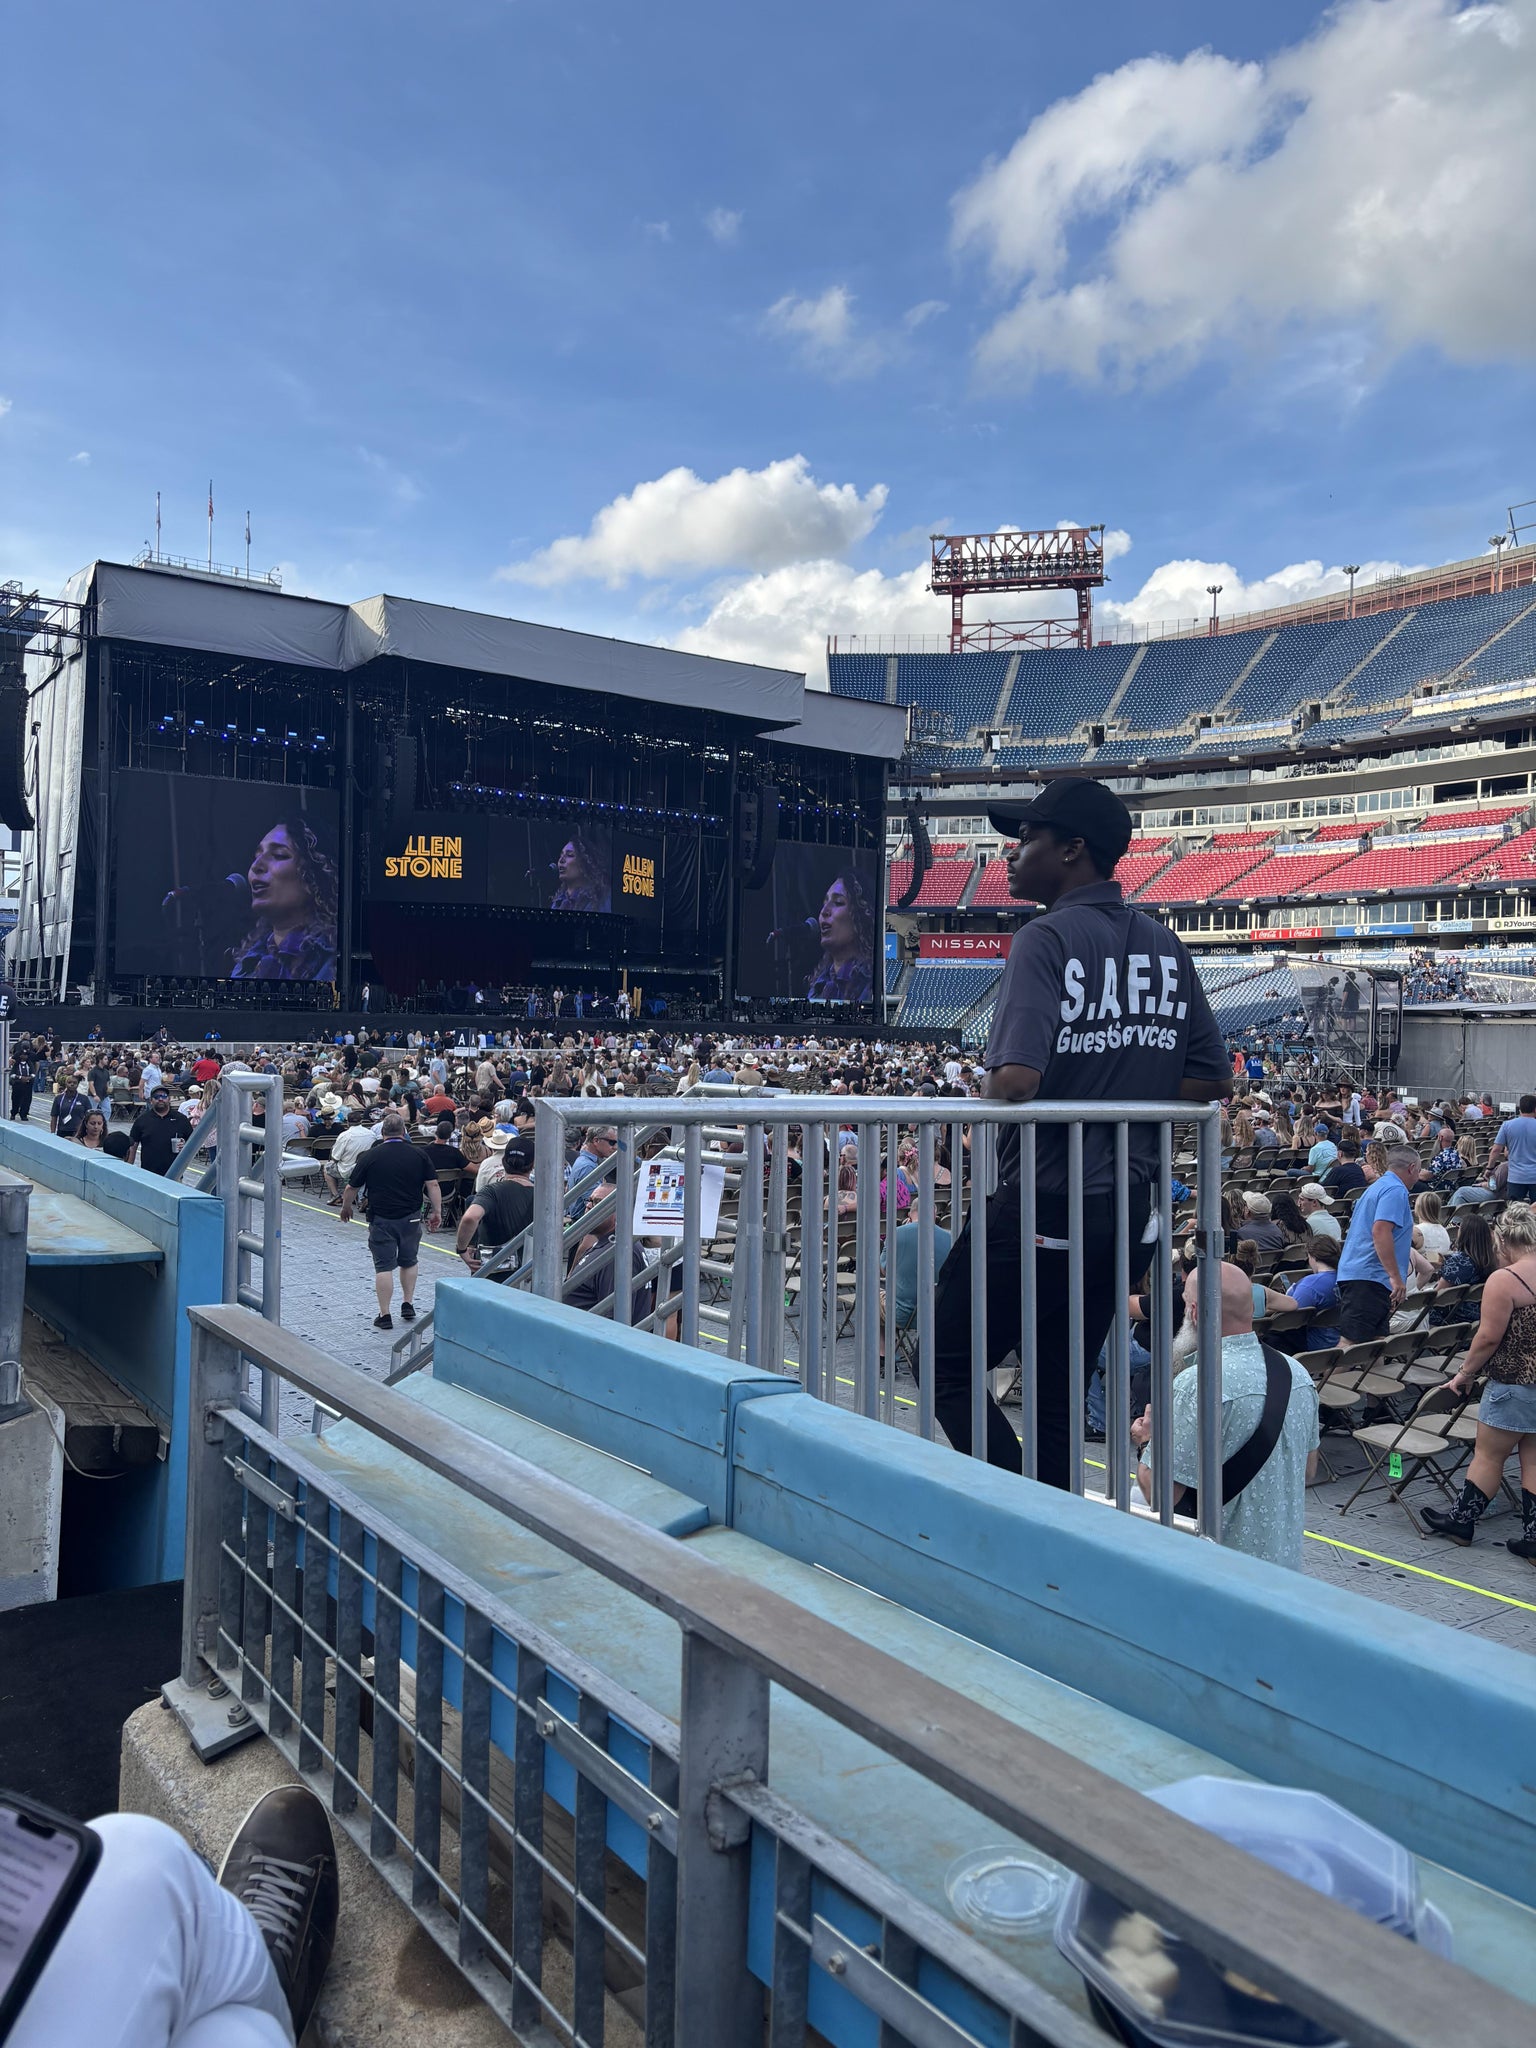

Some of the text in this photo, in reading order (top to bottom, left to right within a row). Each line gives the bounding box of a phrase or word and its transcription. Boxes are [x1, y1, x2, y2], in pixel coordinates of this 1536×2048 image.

[404, 835, 462, 857] LLEN
[385, 856, 463, 879] STONE
[622, 854, 655, 877] ALLEN
[622, 873, 655, 898] STONE
[931, 939, 1001, 949] NISSAN
[1060, 954, 1188, 1023] S.AF.E.
[458, 1033, 466, 1046] A
